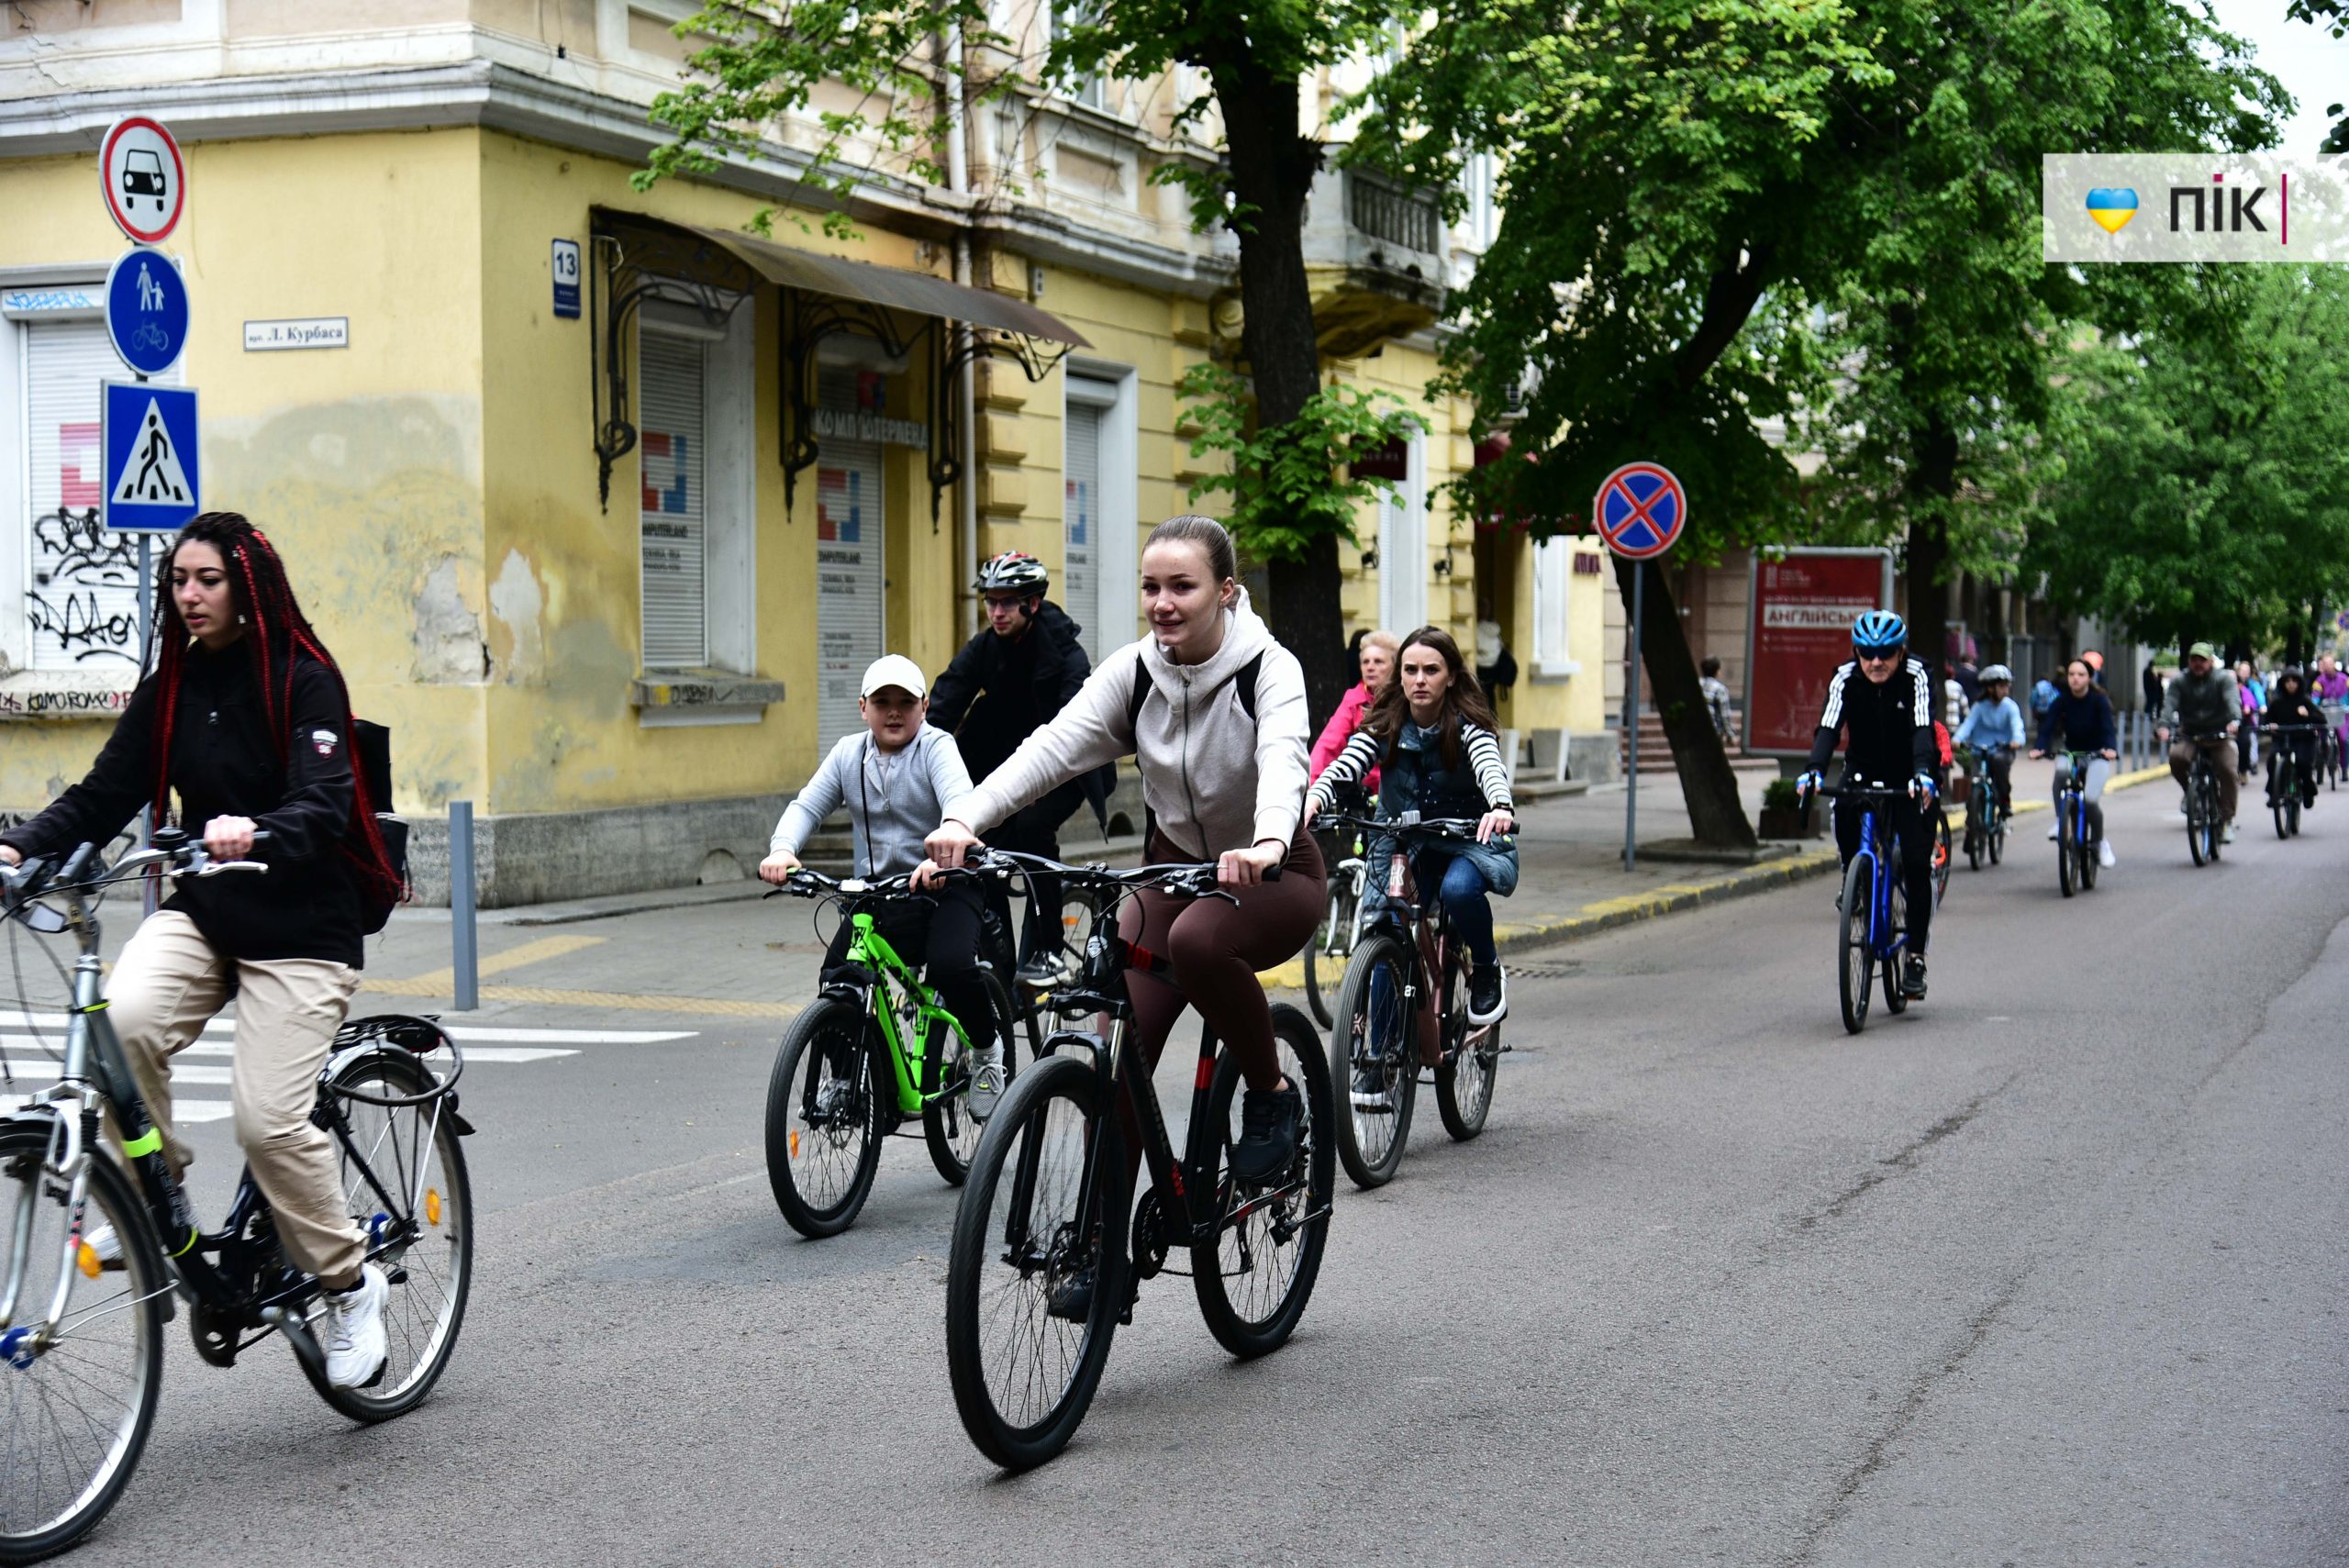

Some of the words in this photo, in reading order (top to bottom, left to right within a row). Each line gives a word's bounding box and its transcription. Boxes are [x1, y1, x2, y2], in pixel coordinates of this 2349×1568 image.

[556, 250, 576, 276] 13
[287, 325, 343, 343] Курбаса
[1768, 608, 1860, 624] АНГЛІЙСЬК
